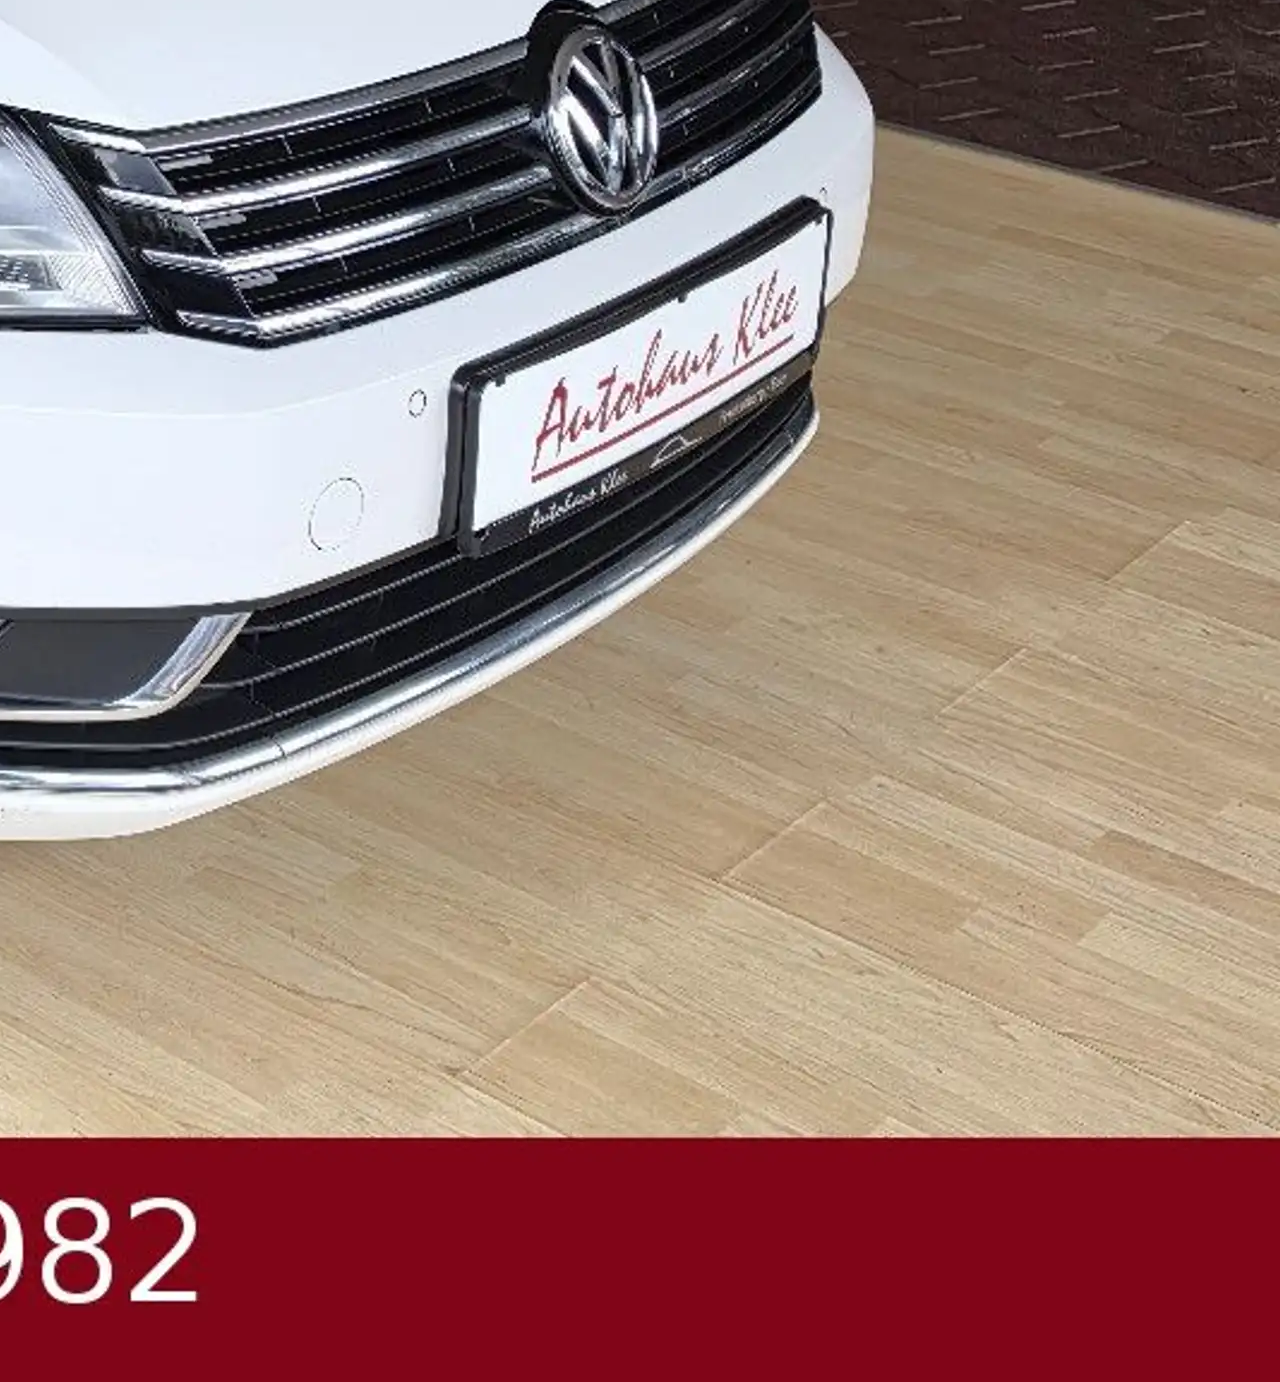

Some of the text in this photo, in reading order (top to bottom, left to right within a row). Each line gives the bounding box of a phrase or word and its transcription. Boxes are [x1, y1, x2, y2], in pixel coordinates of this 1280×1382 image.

[532, 329, 724, 471] Autohaus
[732, 268, 799, 366] Klee
[528, 467, 630, 535] Autohaus Klee
